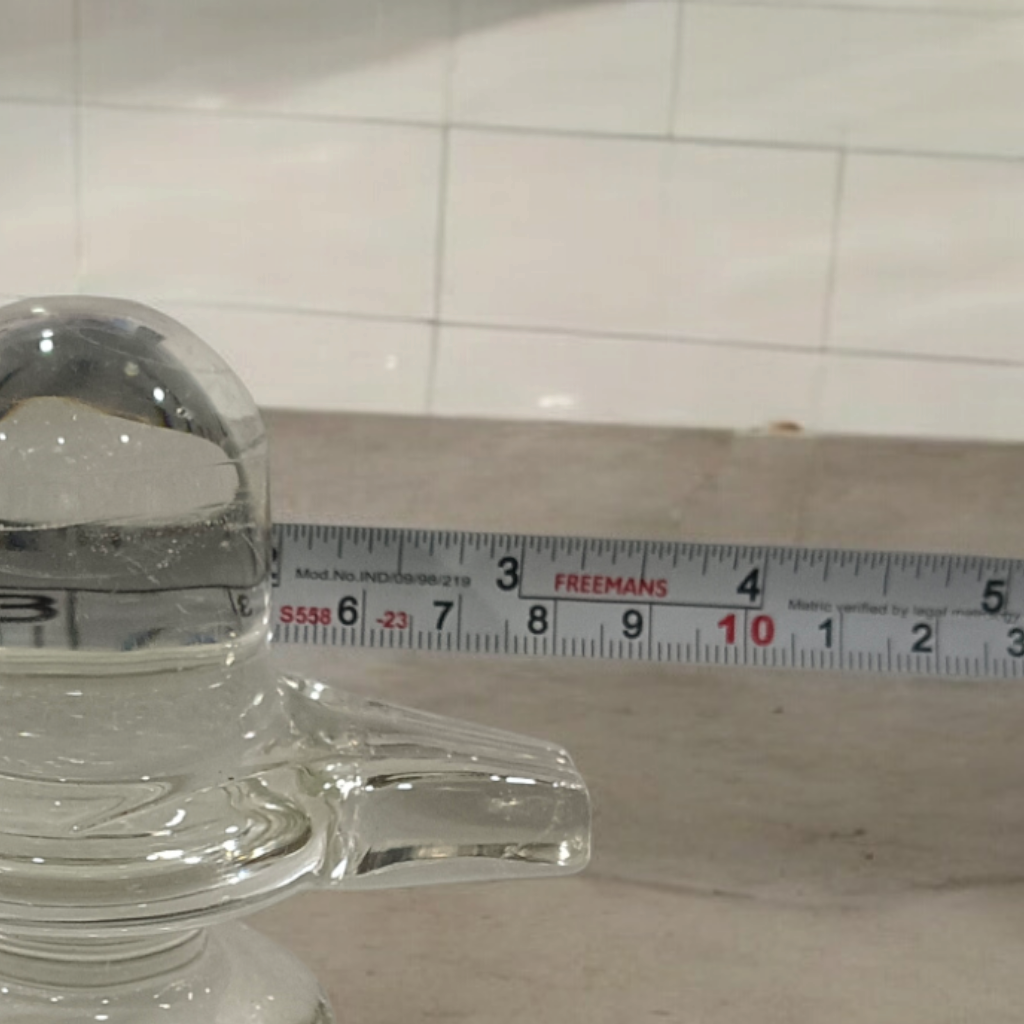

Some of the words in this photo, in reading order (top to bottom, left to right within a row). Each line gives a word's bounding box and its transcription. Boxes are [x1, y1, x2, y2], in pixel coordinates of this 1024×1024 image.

[496, 556, 519, 591] 3
[737, 568, 760, 602] 4
[981, 579, 1006, 614] 5
[554, 573, 668, 598] FREEMANS
[280, 606, 331, 626] S558
[376, 611, 408, 629] -23
[337, 596, 359, 626] 6
[433, 601, 454, 631] 7
[527, 605, 548, 635] 8
[622, 610, 643, 640] 9
[718, 613, 775, 647] 10
[819, 618, 834, 649] 1
[912, 623, 933, 654] 2
[1007, 627, 1024, 658] 3
